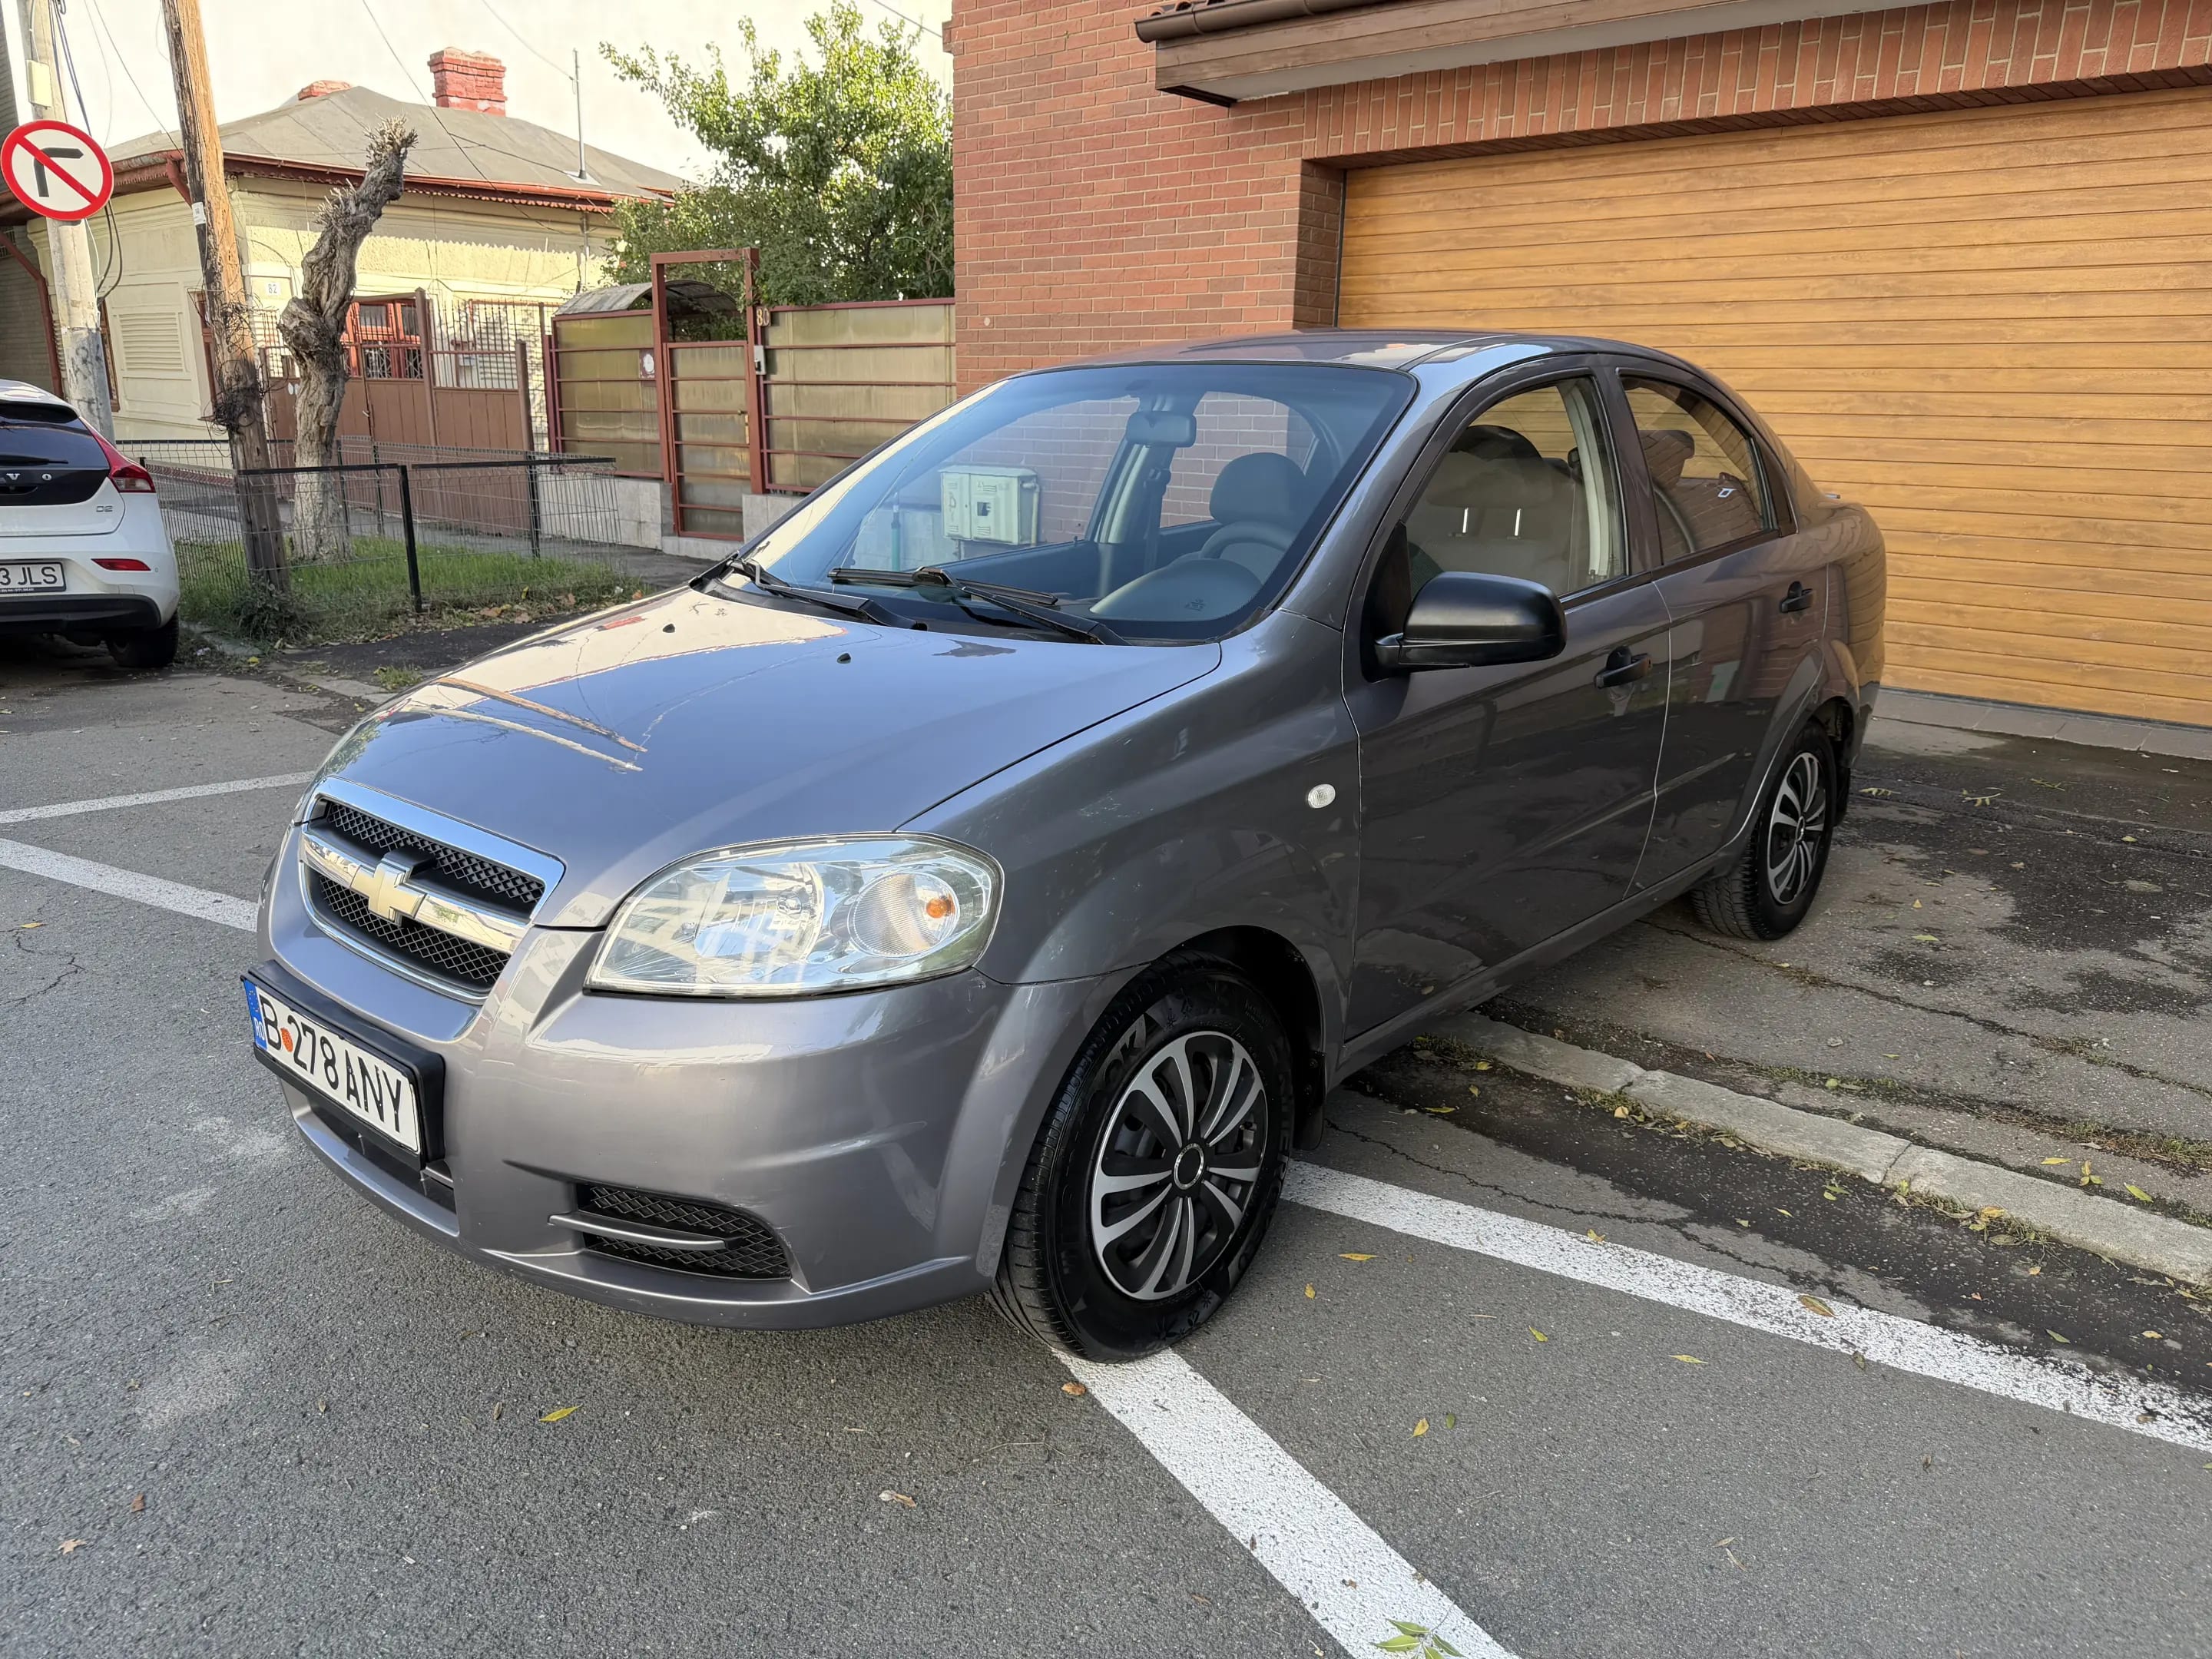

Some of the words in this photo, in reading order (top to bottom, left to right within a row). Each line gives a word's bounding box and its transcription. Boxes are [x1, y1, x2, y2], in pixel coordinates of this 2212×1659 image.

[756, 308, 771, 326] 80
[18, 566, 58, 585] JLS
[253, 1016, 266, 1041] RO
[259, 995, 282, 1051] B
[286, 1015, 339, 1091] 278
[344, 1048, 402, 1133] ANY
